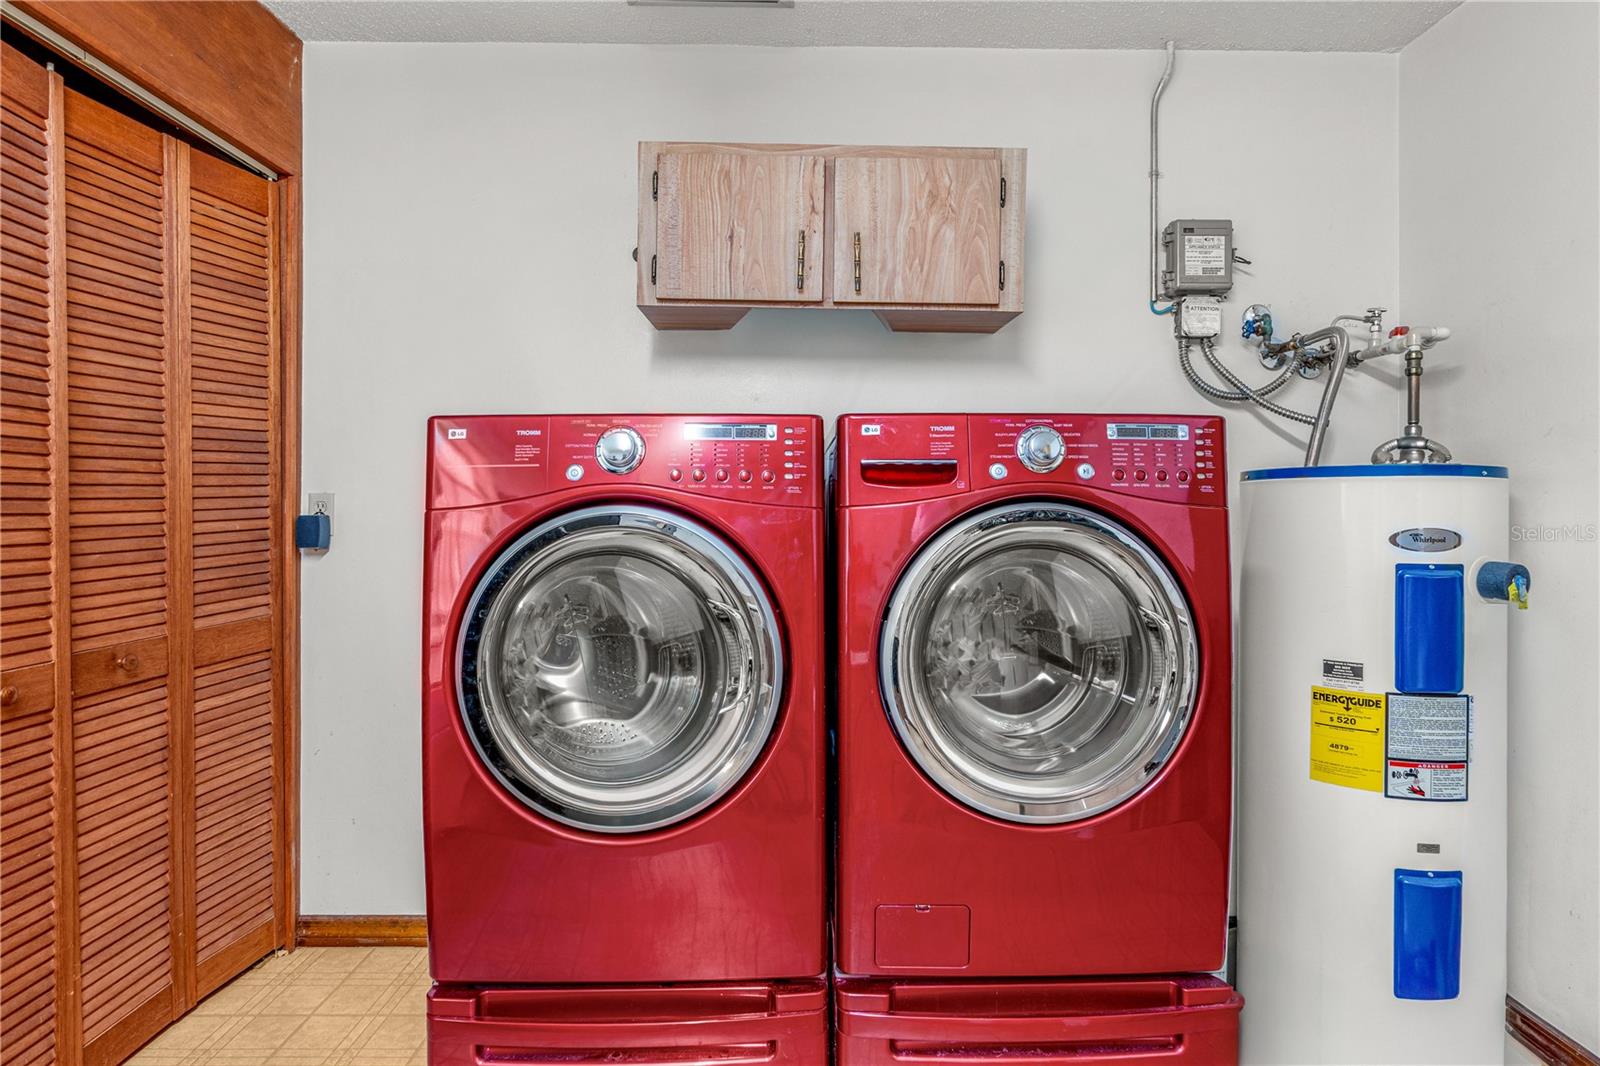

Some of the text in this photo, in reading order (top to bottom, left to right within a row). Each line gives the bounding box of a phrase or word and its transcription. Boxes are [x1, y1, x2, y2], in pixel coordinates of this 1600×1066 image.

[1412, 535, 1446, 544] Whirlpool
[1313, 692, 1382, 709] ENERGYGUIDE
[1336, 716, 1357, 726] 520
[1329, 743, 1349, 751] 4879
